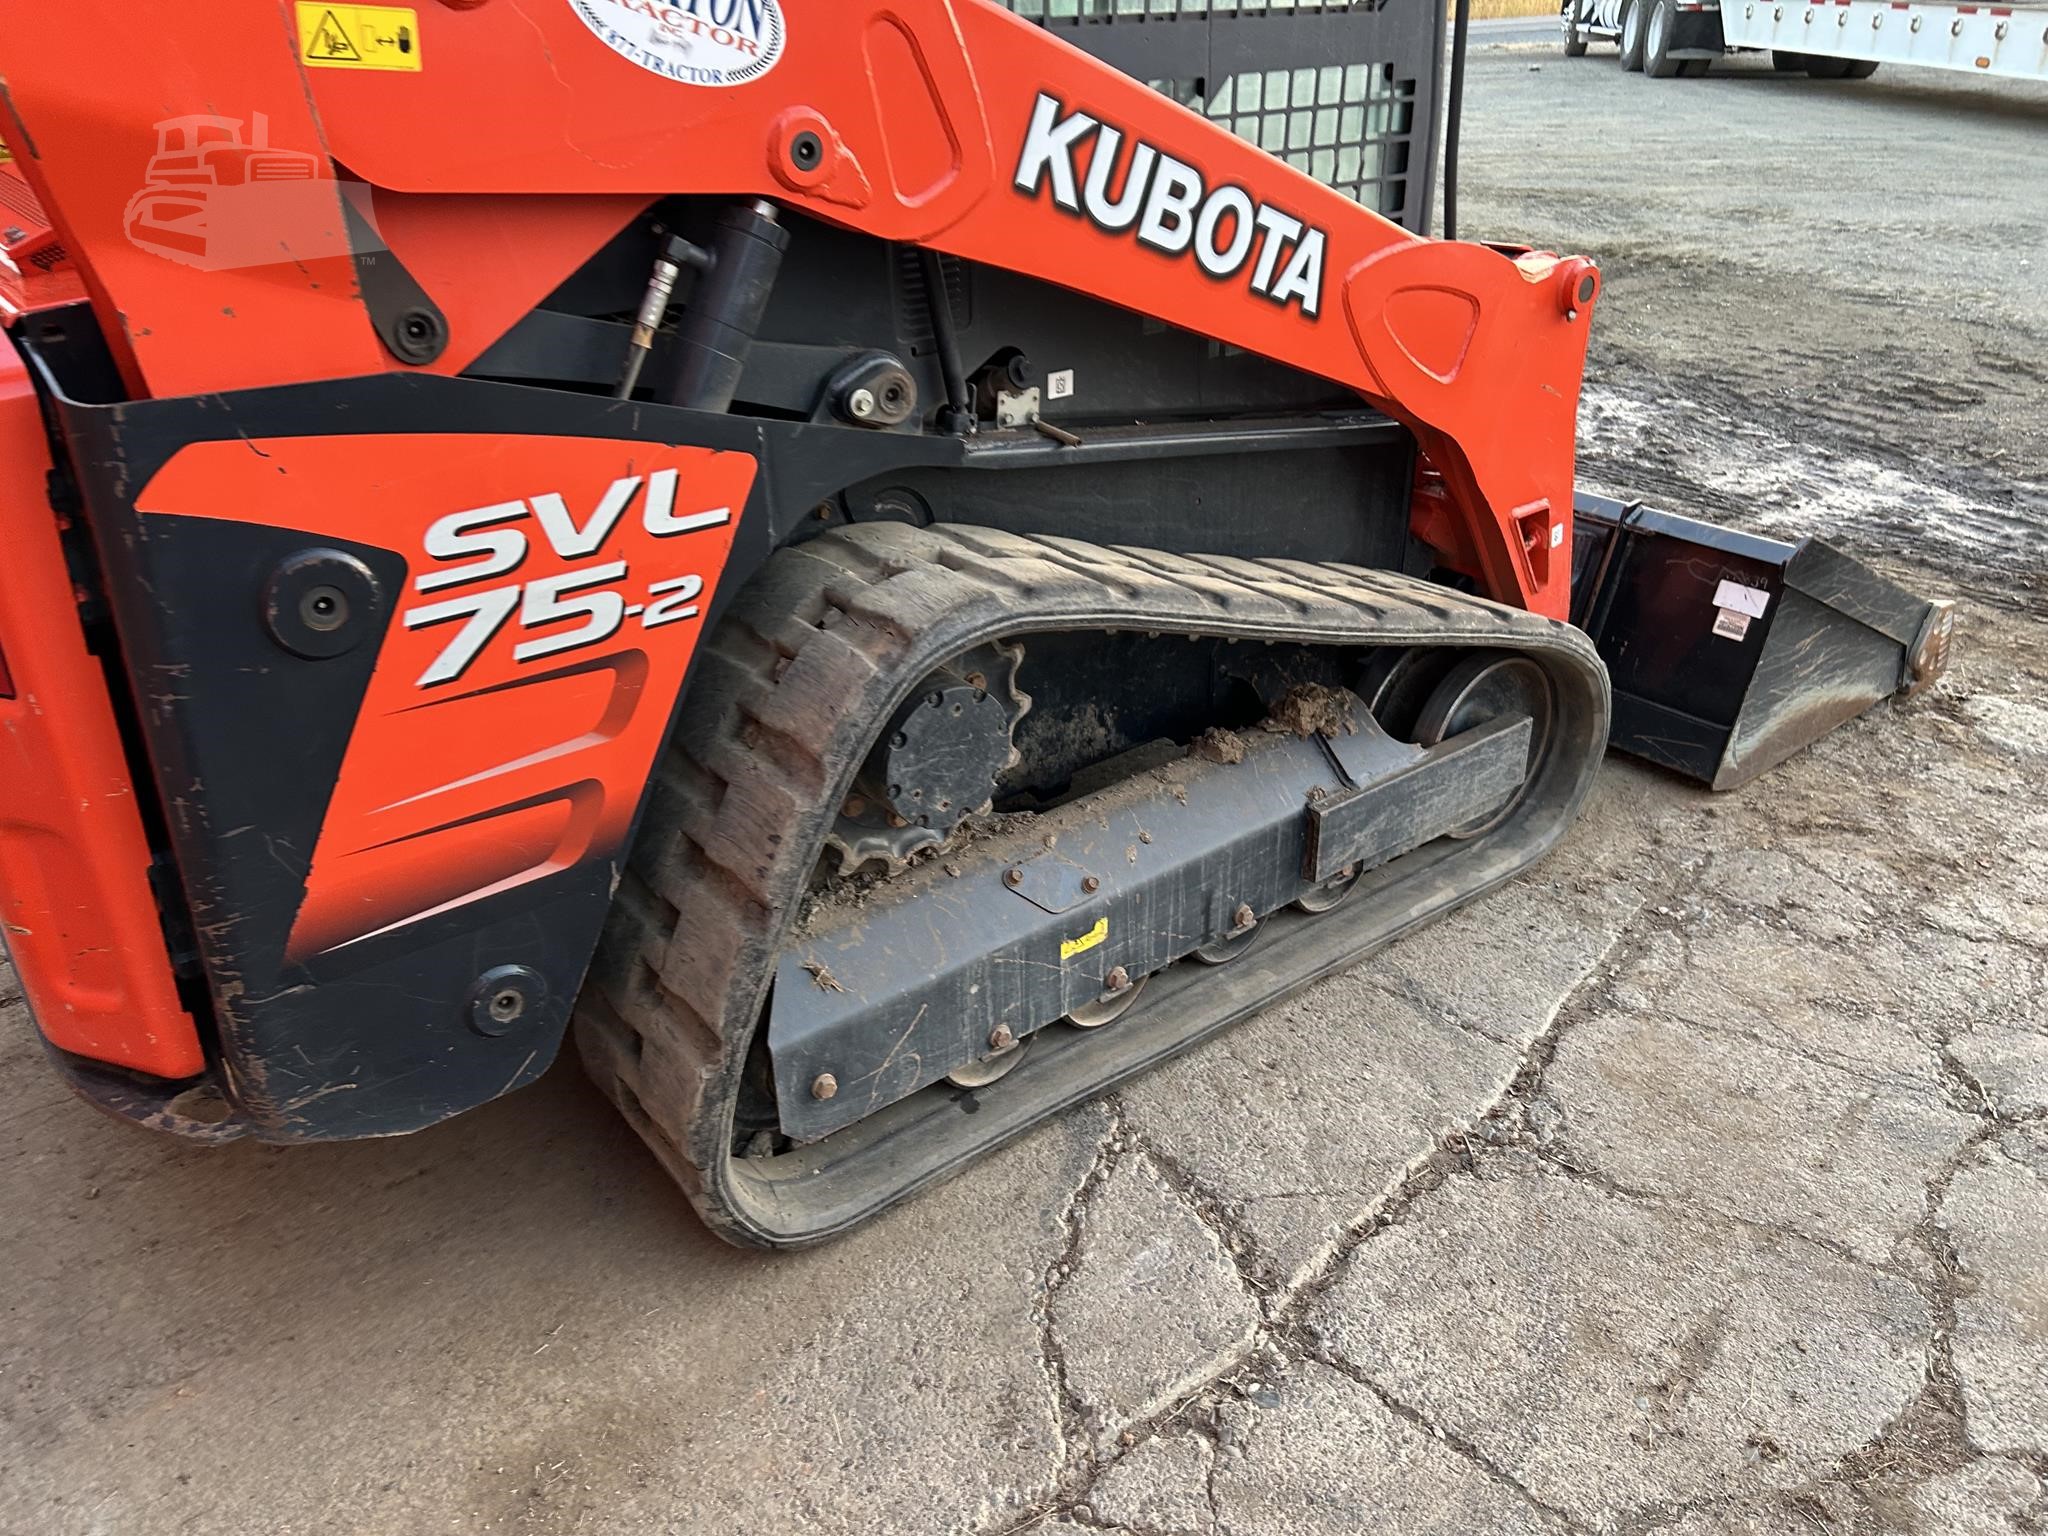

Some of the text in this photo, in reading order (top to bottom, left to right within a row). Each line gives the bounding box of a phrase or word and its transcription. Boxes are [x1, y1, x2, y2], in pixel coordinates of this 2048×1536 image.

[606, 29, 724, 84] 877-TRACTOR
[1014, 91, 1327, 317] KUBOTA
[415, 467, 732, 595] SVL
[403, 559, 704, 690] 75-2
